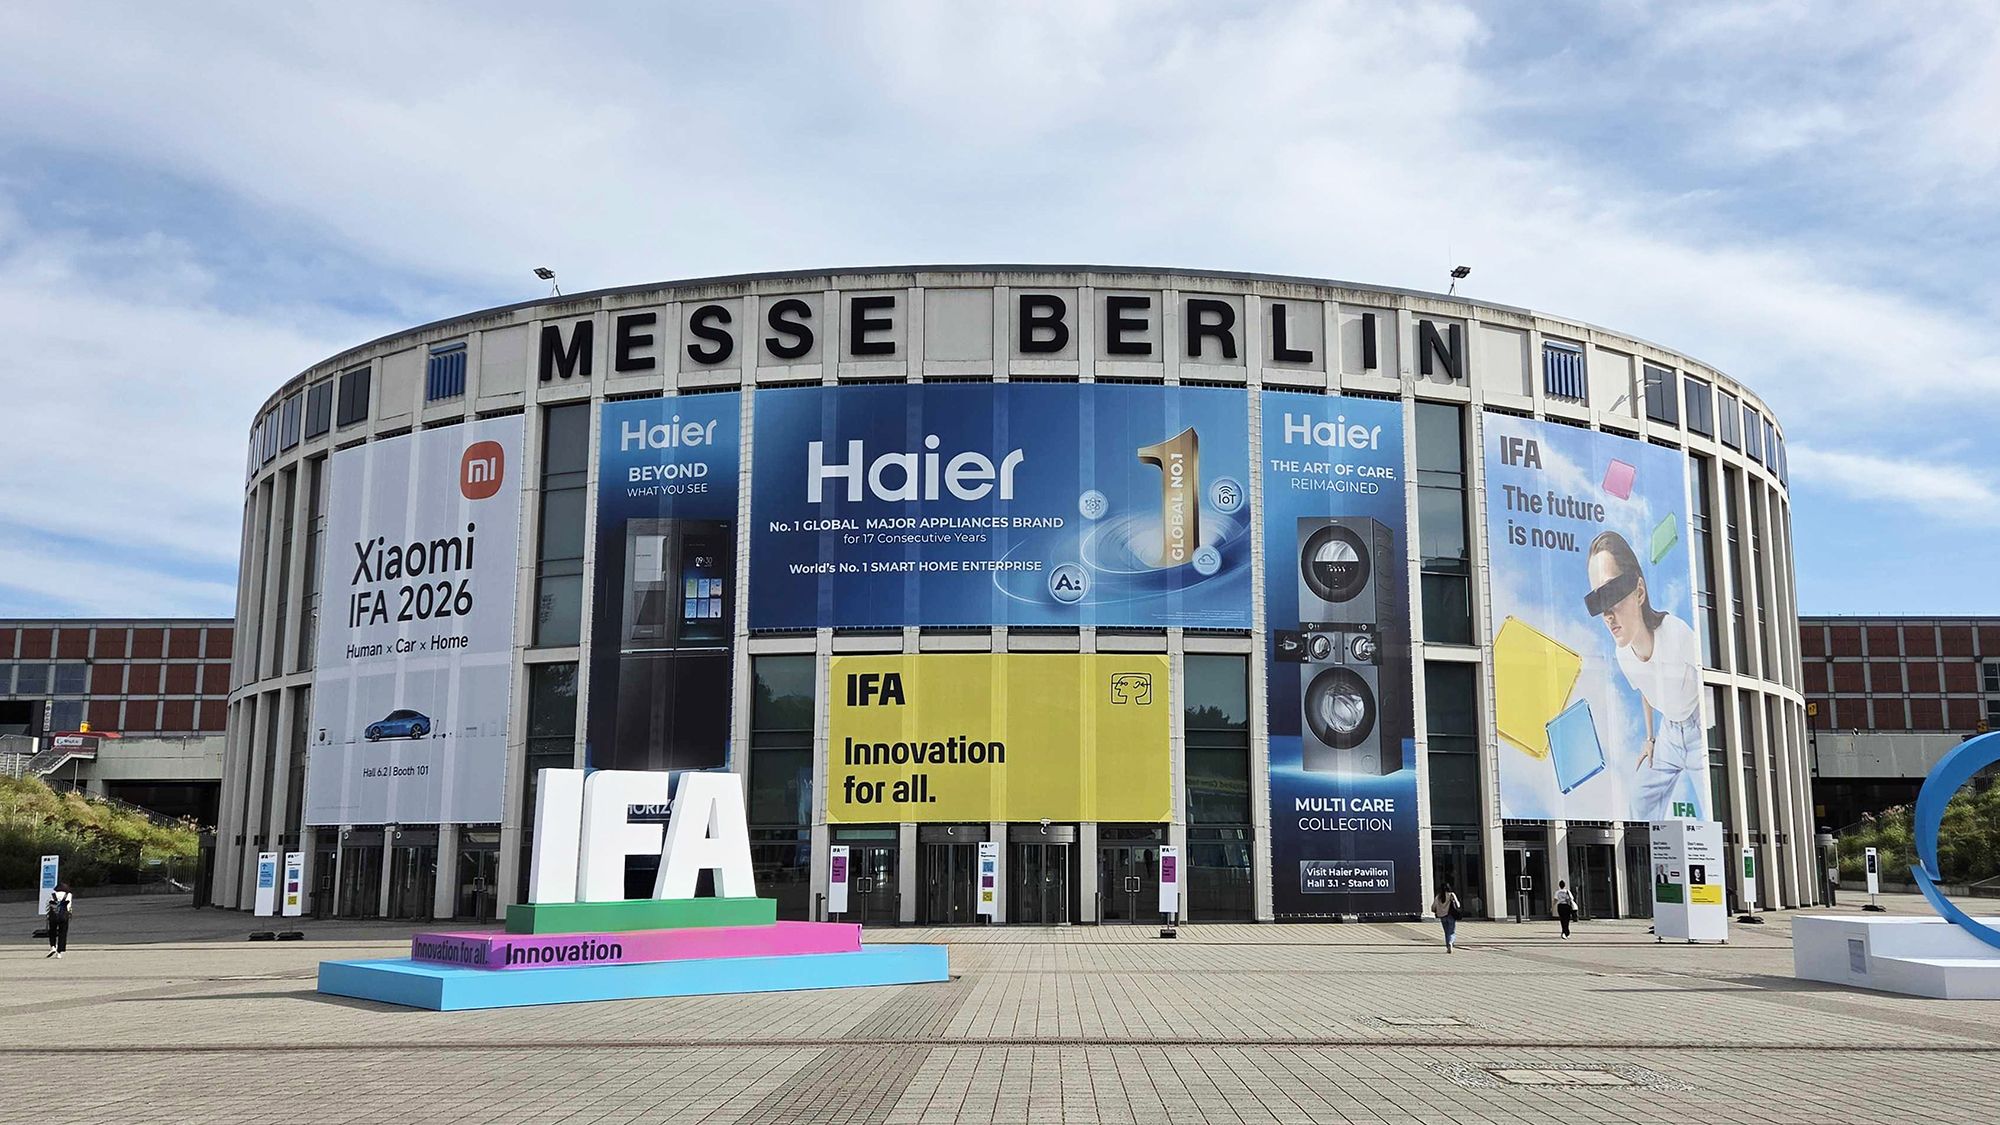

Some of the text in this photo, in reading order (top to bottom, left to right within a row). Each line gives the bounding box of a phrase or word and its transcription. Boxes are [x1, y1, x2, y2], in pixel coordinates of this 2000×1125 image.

[540, 294, 1463, 381] MESSE BERLIN
[621, 415, 717, 451] Haier
[1284, 413, 1381, 450] Haier
[1500, 435, 1542, 469] IFA
[628, 462, 708, 482] BEYOND
[807, 434, 1024, 503] Haier
[1271, 460, 1397, 481] THE ART OF CARE,
[627, 483, 708, 497] WHAT YOU SEE
[1291, 478, 1379, 494] REIMAGINED
[1171, 453, 1184, 561] GLOBAL NO.1
[1218, 494, 1236, 505] IoT
[1502, 484, 1605, 523] The future
[770, 517, 1064, 532] No. 1 GLOBAL MAJOR APPLIANCES BRAND
[1508, 519, 1580, 552] is now.
[843, 532, 987, 544] for 17 Consecutive Years
[351, 522, 475, 586] Xiaomi
[789, 560, 1042, 574] World's No. 1 SMART HOME ENTERPRISE
[349, 579, 473, 628] IFA 2026
[346, 644, 382, 659] Human
[396, 638, 416, 653] Car
[431, 635, 468, 650] Home
[846, 672, 906, 707] IFA
[844, 735, 1006, 765] Innovation
[363, 768, 376, 777] Hall
[377, 767, 388, 777] 6.2
[393, 766, 414, 776] Booth
[417, 765, 428, 775] 101
[844, 774, 936, 804] for all.
[1295, 798, 1395, 812] MULTI CARE
[1672, 802, 1696, 817] IFA
[528, 768, 757, 904] IFA
[1298, 817, 1392, 831] COLLECTION
[1306, 867, 1388, 876] Visit Haier Pavilion
[1307, 879, 1325, 888] Hall
[1328, 879, 1339, 888] 3.1
[1348, 879, 1374, 888] Stand
[1376, 879, 1389, 888] 101
[415, 937, 488, 965] Innovation for all.
[506, 940, 622, 965] Innovation
